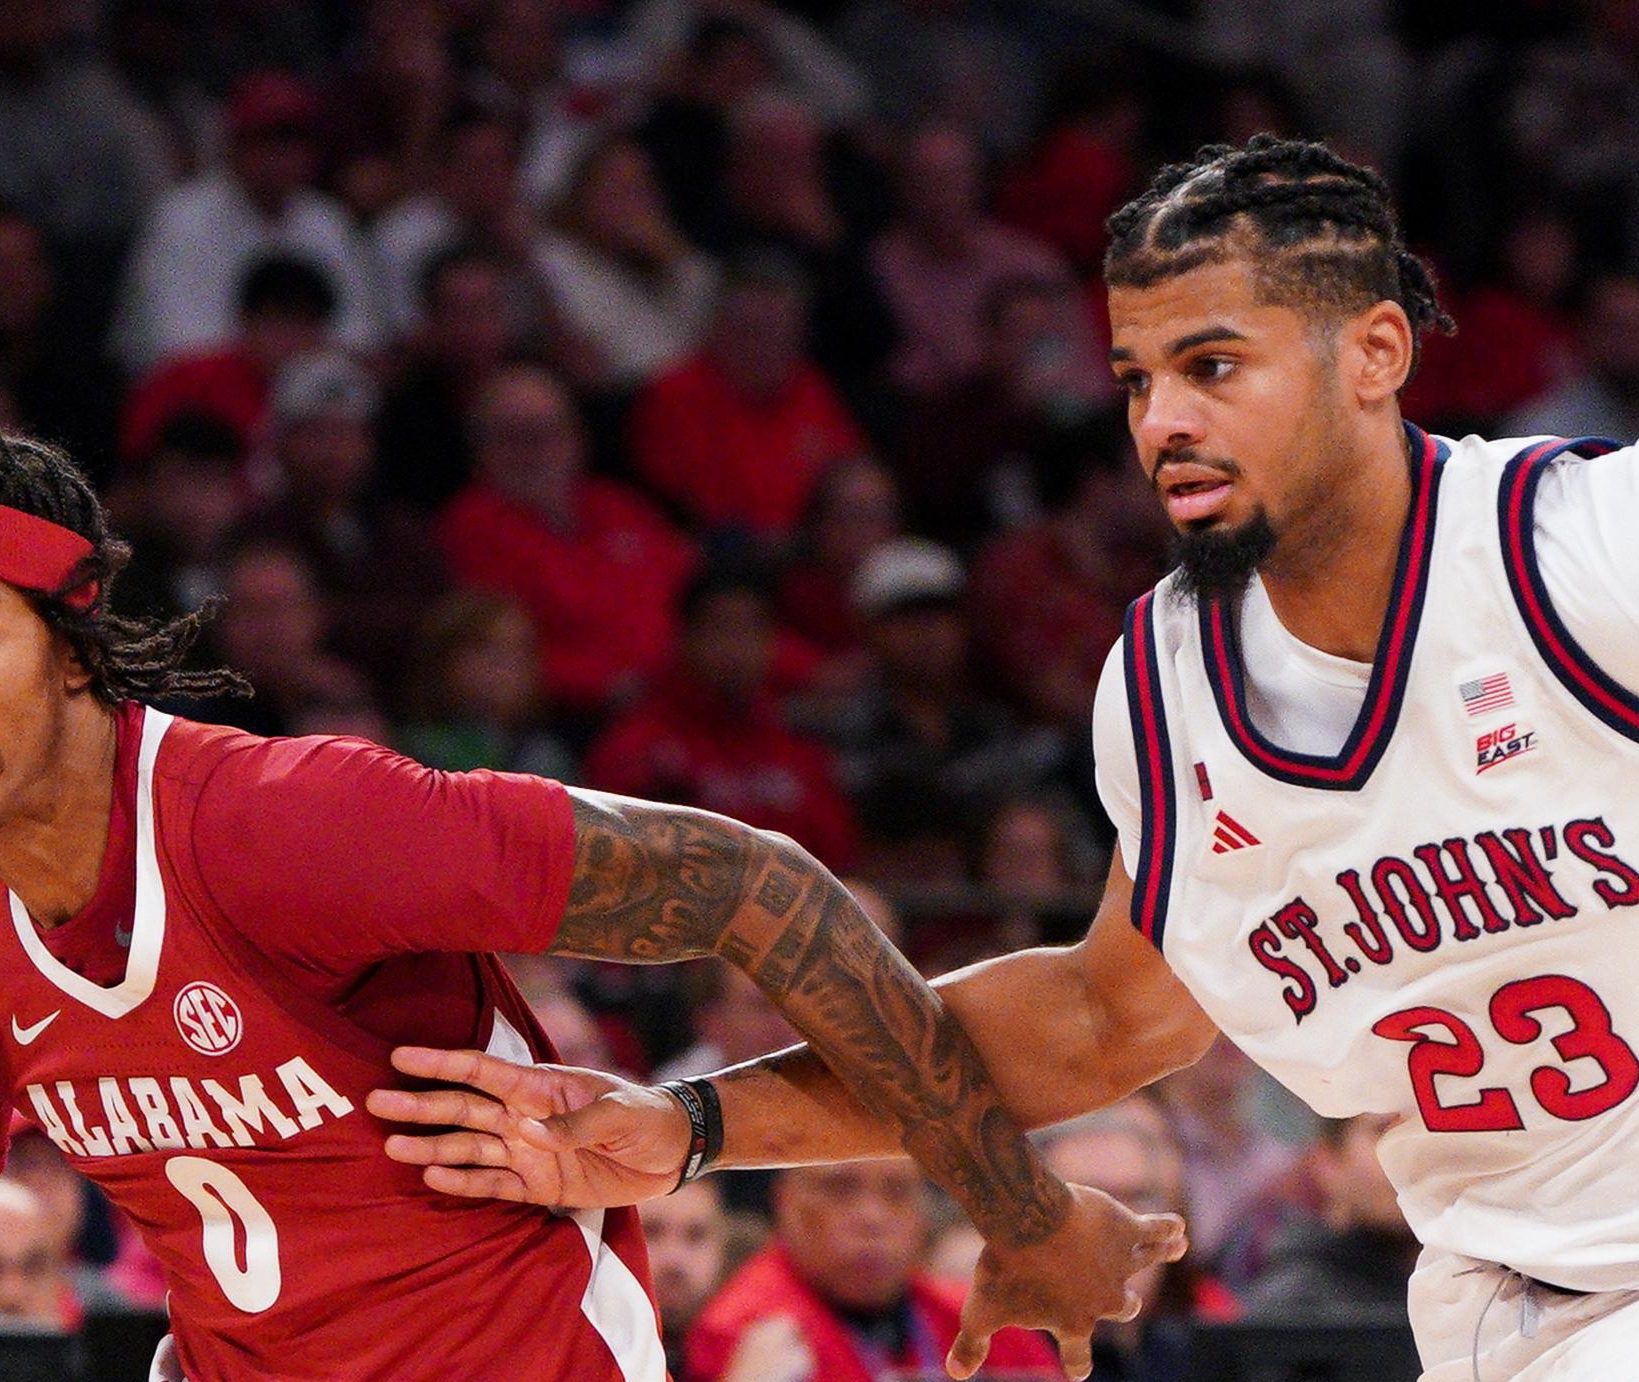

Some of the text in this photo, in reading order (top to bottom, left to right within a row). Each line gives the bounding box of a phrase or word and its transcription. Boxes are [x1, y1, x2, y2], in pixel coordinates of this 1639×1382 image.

[1477, 723, 1516, 752] BIG
[1477, 731, 1536, 766] EAST
[179, 986, 235, 1050] SEC
[26, 1056, 355, 1157] ALABAMA
[165, 1155, 281, 1313] 0
